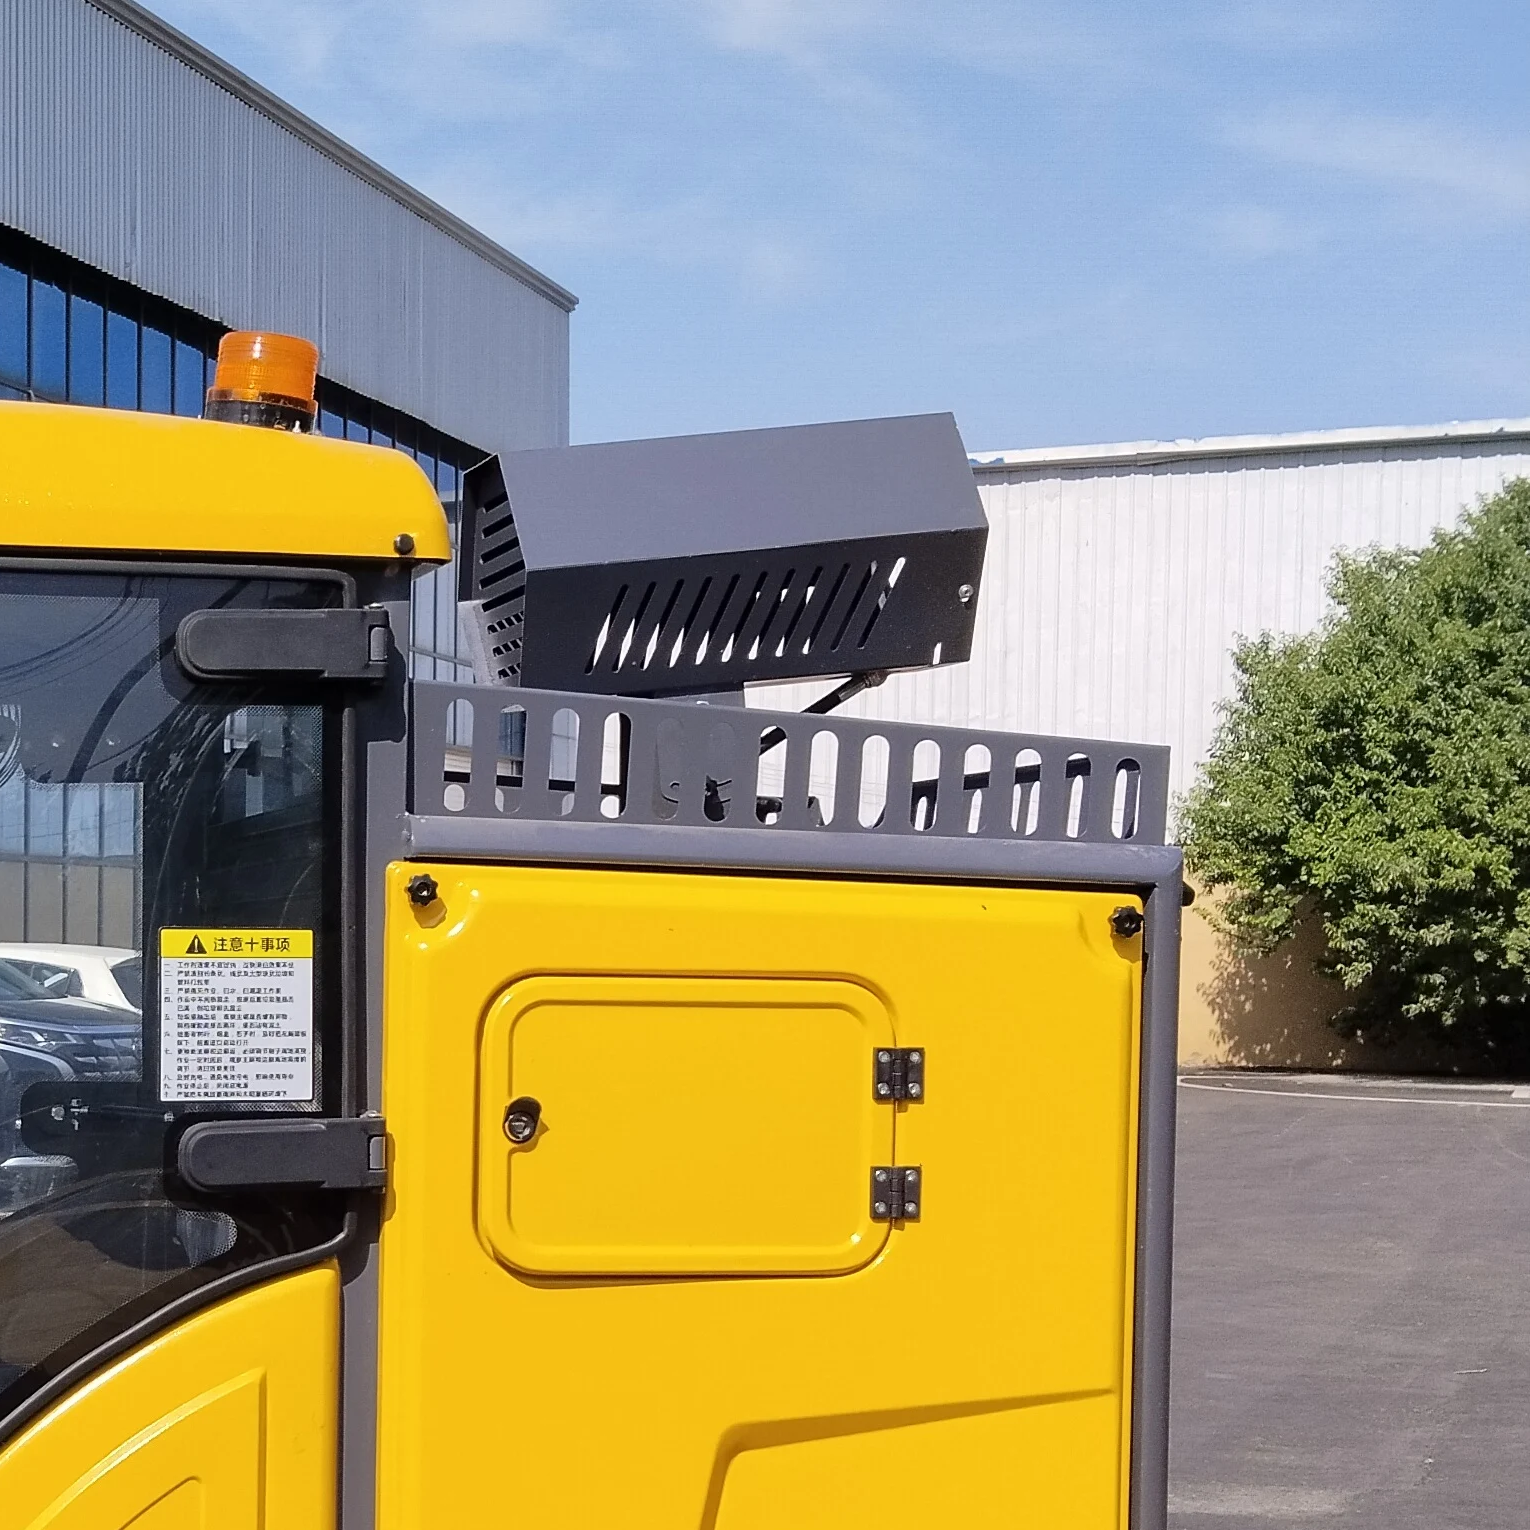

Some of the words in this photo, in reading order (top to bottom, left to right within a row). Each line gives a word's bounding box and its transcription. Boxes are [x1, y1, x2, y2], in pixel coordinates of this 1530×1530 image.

[214, 936, 291, 953] 注意十事项
